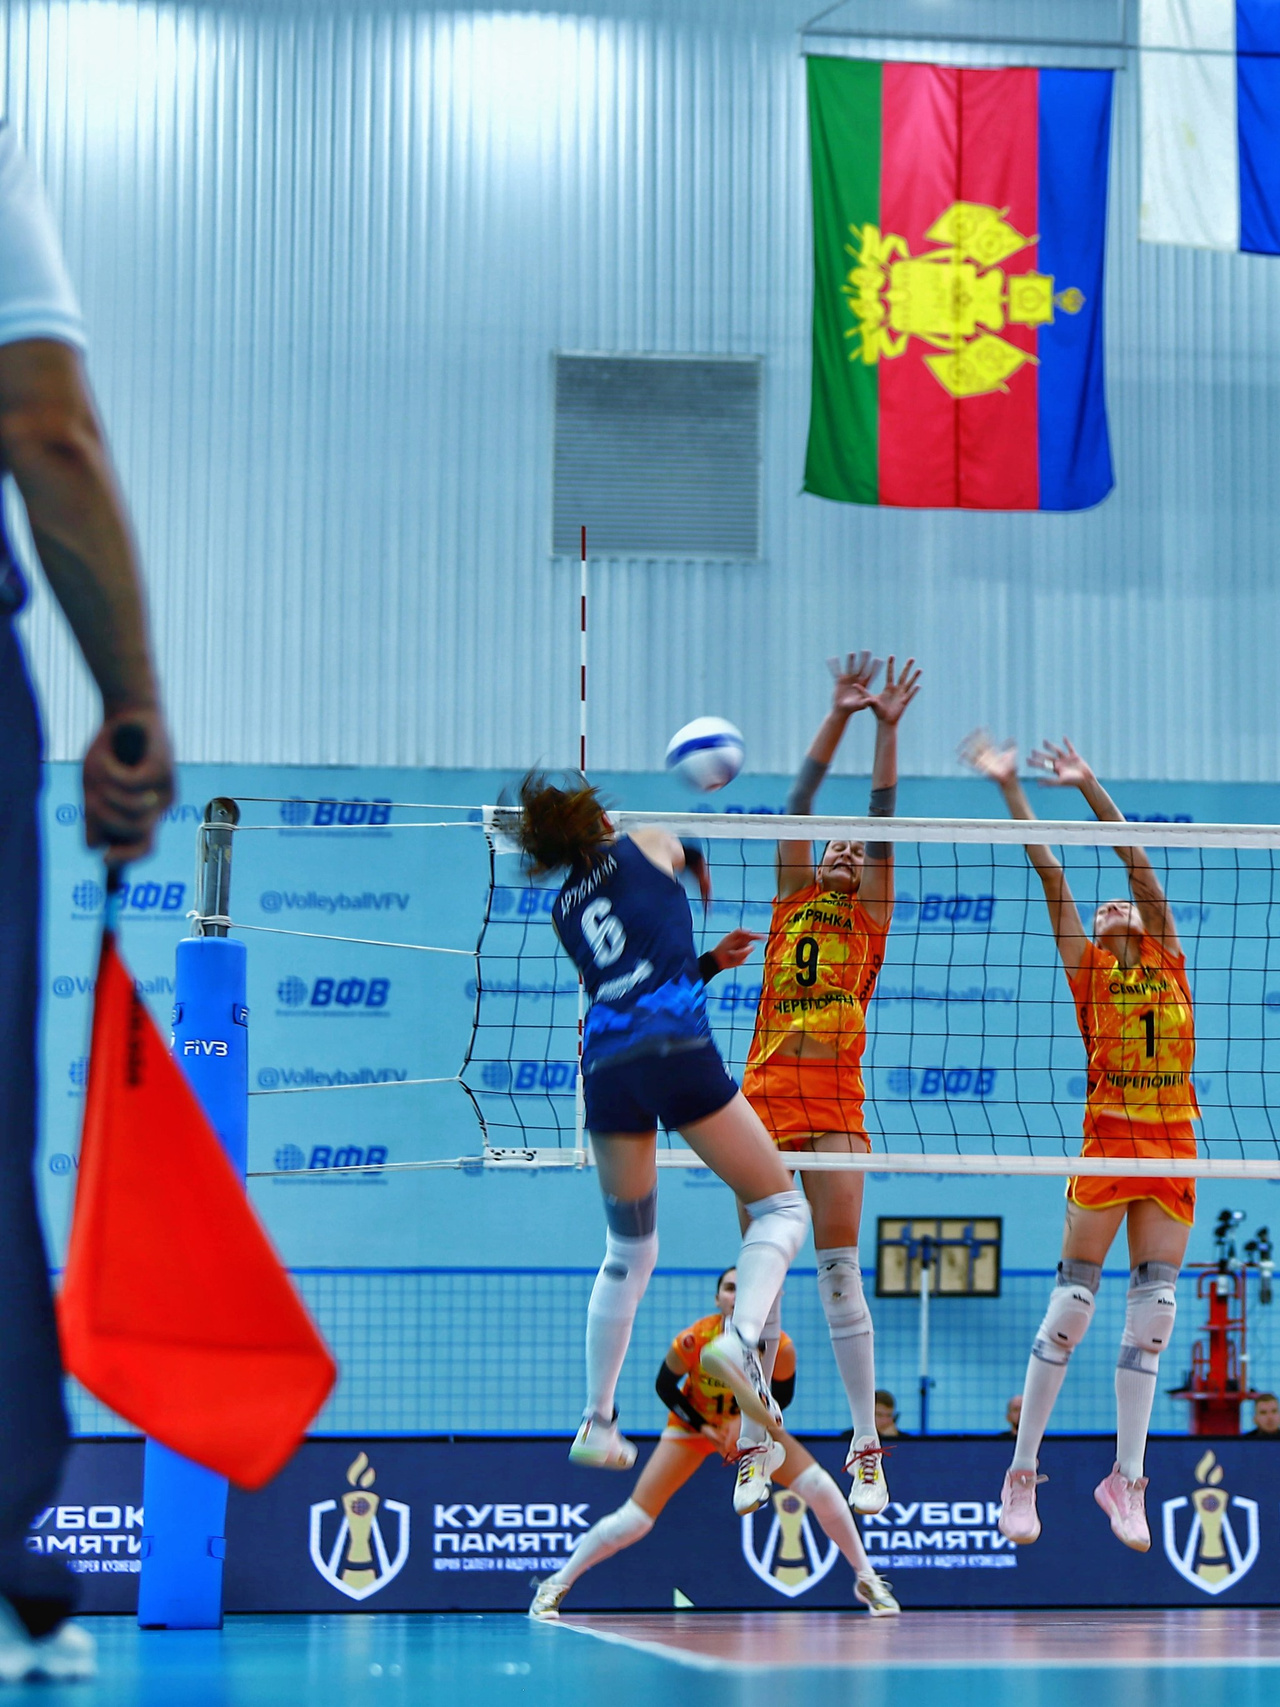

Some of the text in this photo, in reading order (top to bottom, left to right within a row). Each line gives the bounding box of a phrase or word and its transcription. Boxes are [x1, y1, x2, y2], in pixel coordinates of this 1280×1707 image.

[920, 893, 996, 923] ВФВ
[581, 897, 627, 970] 6
[795, 936, 820, 987] 9
[310, 977, 392, 1008] ВФВ
[1139, 1010, 1155, 1058] 1
[919, 1065, 997, 1096] ВФВ
[433, 1503, 590, 1528] КУБОК
